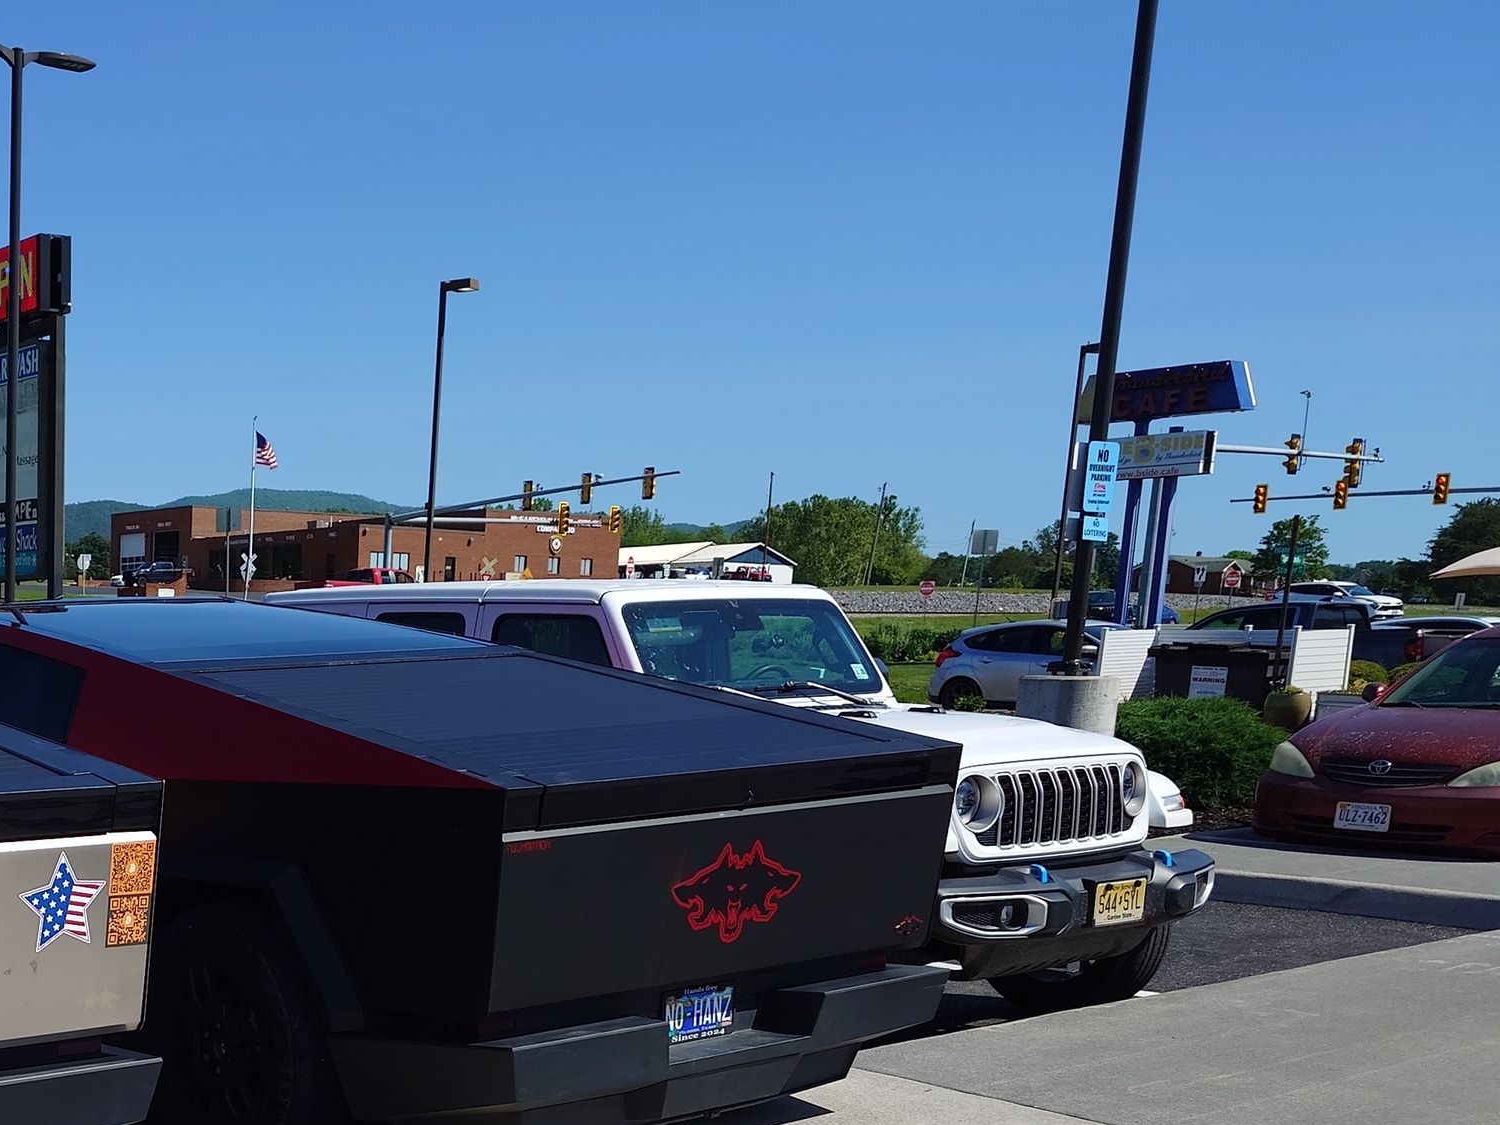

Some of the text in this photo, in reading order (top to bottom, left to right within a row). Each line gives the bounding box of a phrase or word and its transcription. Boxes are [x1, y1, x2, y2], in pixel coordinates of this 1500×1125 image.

[16, 349, 39, 376] ASH
[1112, 388, 1209, 418] CAFE
[16, 454, 39, 467] assage
[1097, 449, 1110, 463] NO
[1089, 463, 1116, 473] OVERNIGHT
[1090, 473, 1112, 482] PARKING
[1092, 520, 1100, 528] NO
[16, 527, 38, 551] Shack
[1083, 529, 1107, 538] LOITERING
[1191, 676, 1226, 684] WARNING
[684, 986, 705, 995] Hands
[705, 984, 719, 992] free
[671, 1032, 699, 1043] Since
[700, 1028, 726, 1038] 2024
